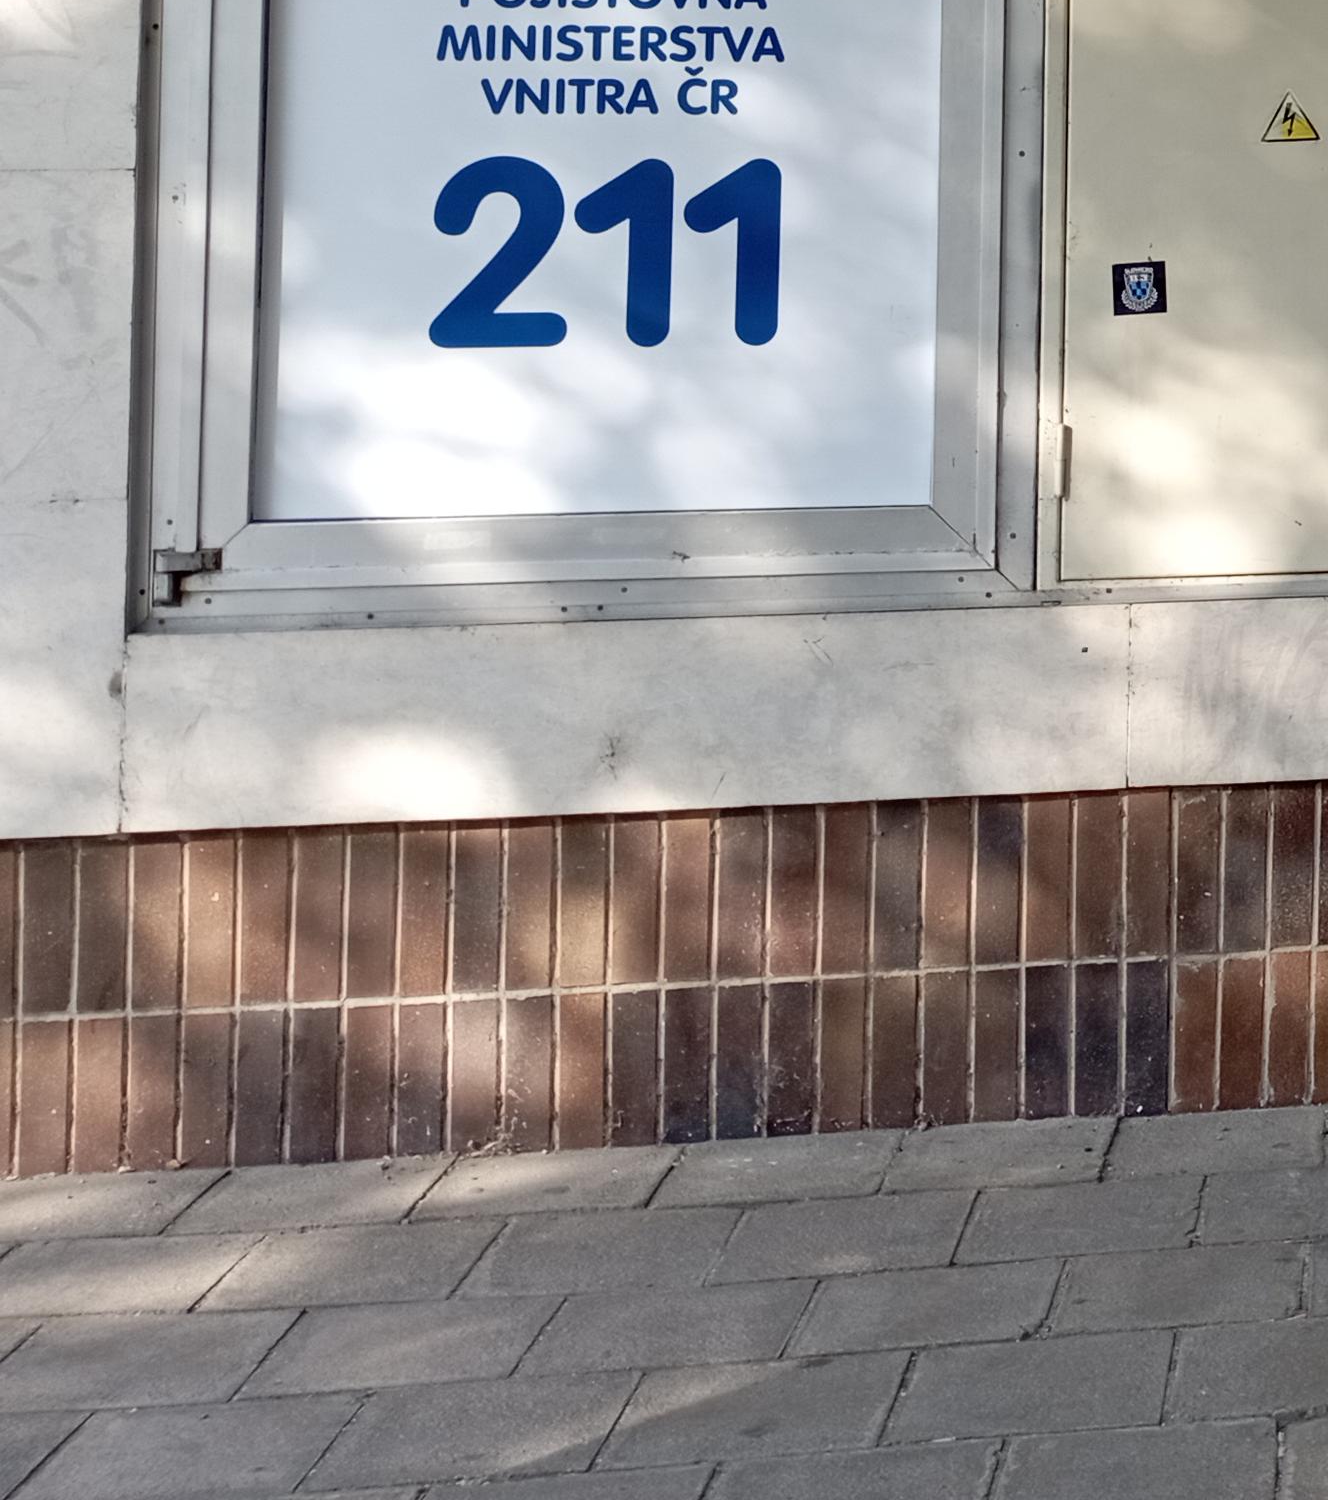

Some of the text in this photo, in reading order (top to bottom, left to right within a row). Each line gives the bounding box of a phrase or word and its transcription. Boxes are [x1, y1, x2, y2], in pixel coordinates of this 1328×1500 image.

[436, 24, 786, 63] MINISTERSTVA
[480, 66, 739, 116] VNITRA ČR
[429, 155, 782, 349] 211
